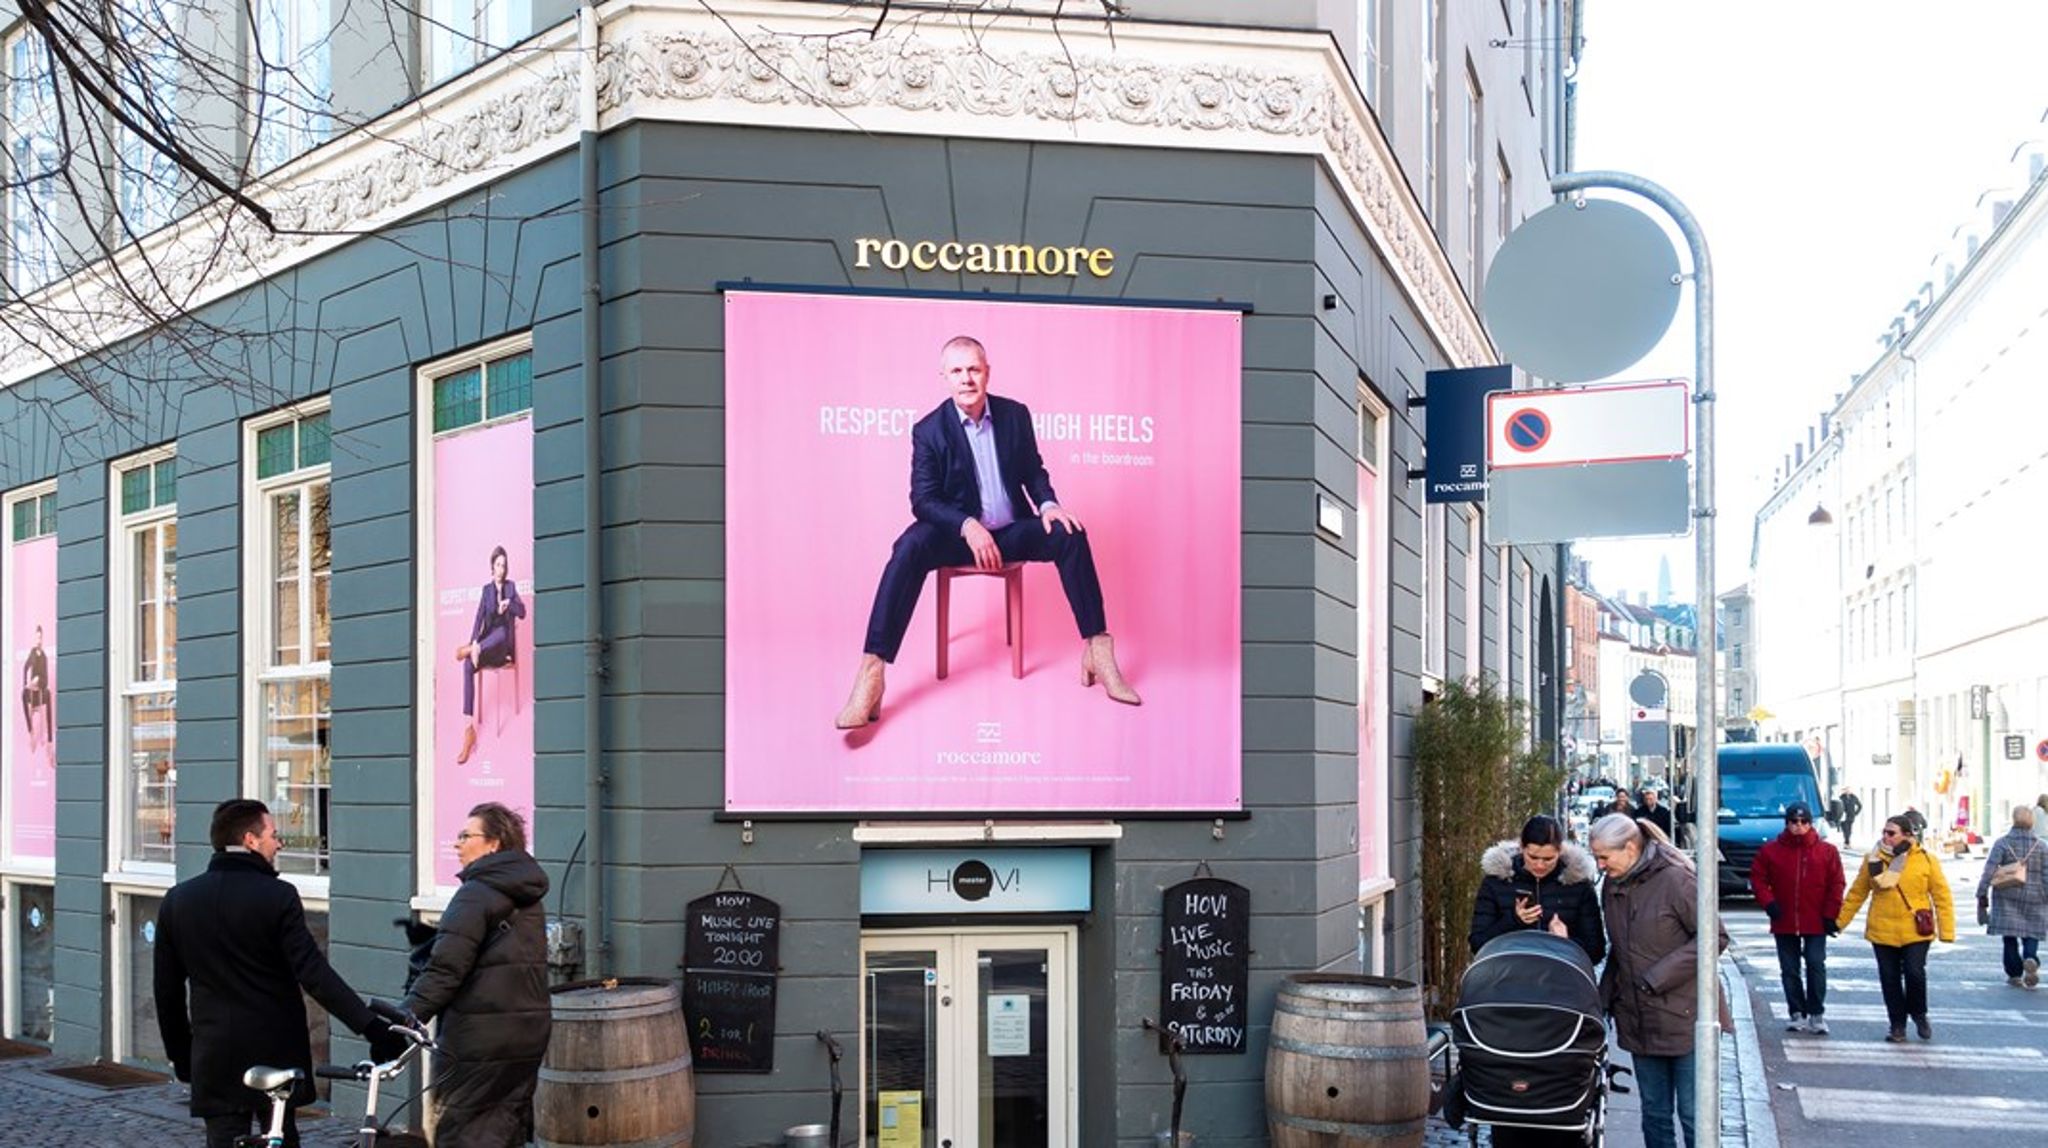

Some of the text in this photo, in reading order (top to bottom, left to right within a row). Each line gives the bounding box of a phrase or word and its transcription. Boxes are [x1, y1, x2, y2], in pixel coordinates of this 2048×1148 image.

[855, 238, 1114, 276] roccamore
[819, 406, 1154, 443] RESPECT HIGH HEELS
[1071, 452, 1155, 467] in the boardroom
[936, 749, 1042, 765] roccamore
[716, 896, 751, 908] HOV!
[1185, 893, 1228, 919] HOV!
[701, 914, 743, 929] MUSIC
[704, 931, 765, 944] TONIGHT
[1195, 1004, 1207, 1020] &
[700, 1016, 714, 1040] 2
[1167, 1020, 1244, 1048] SATURDAY
